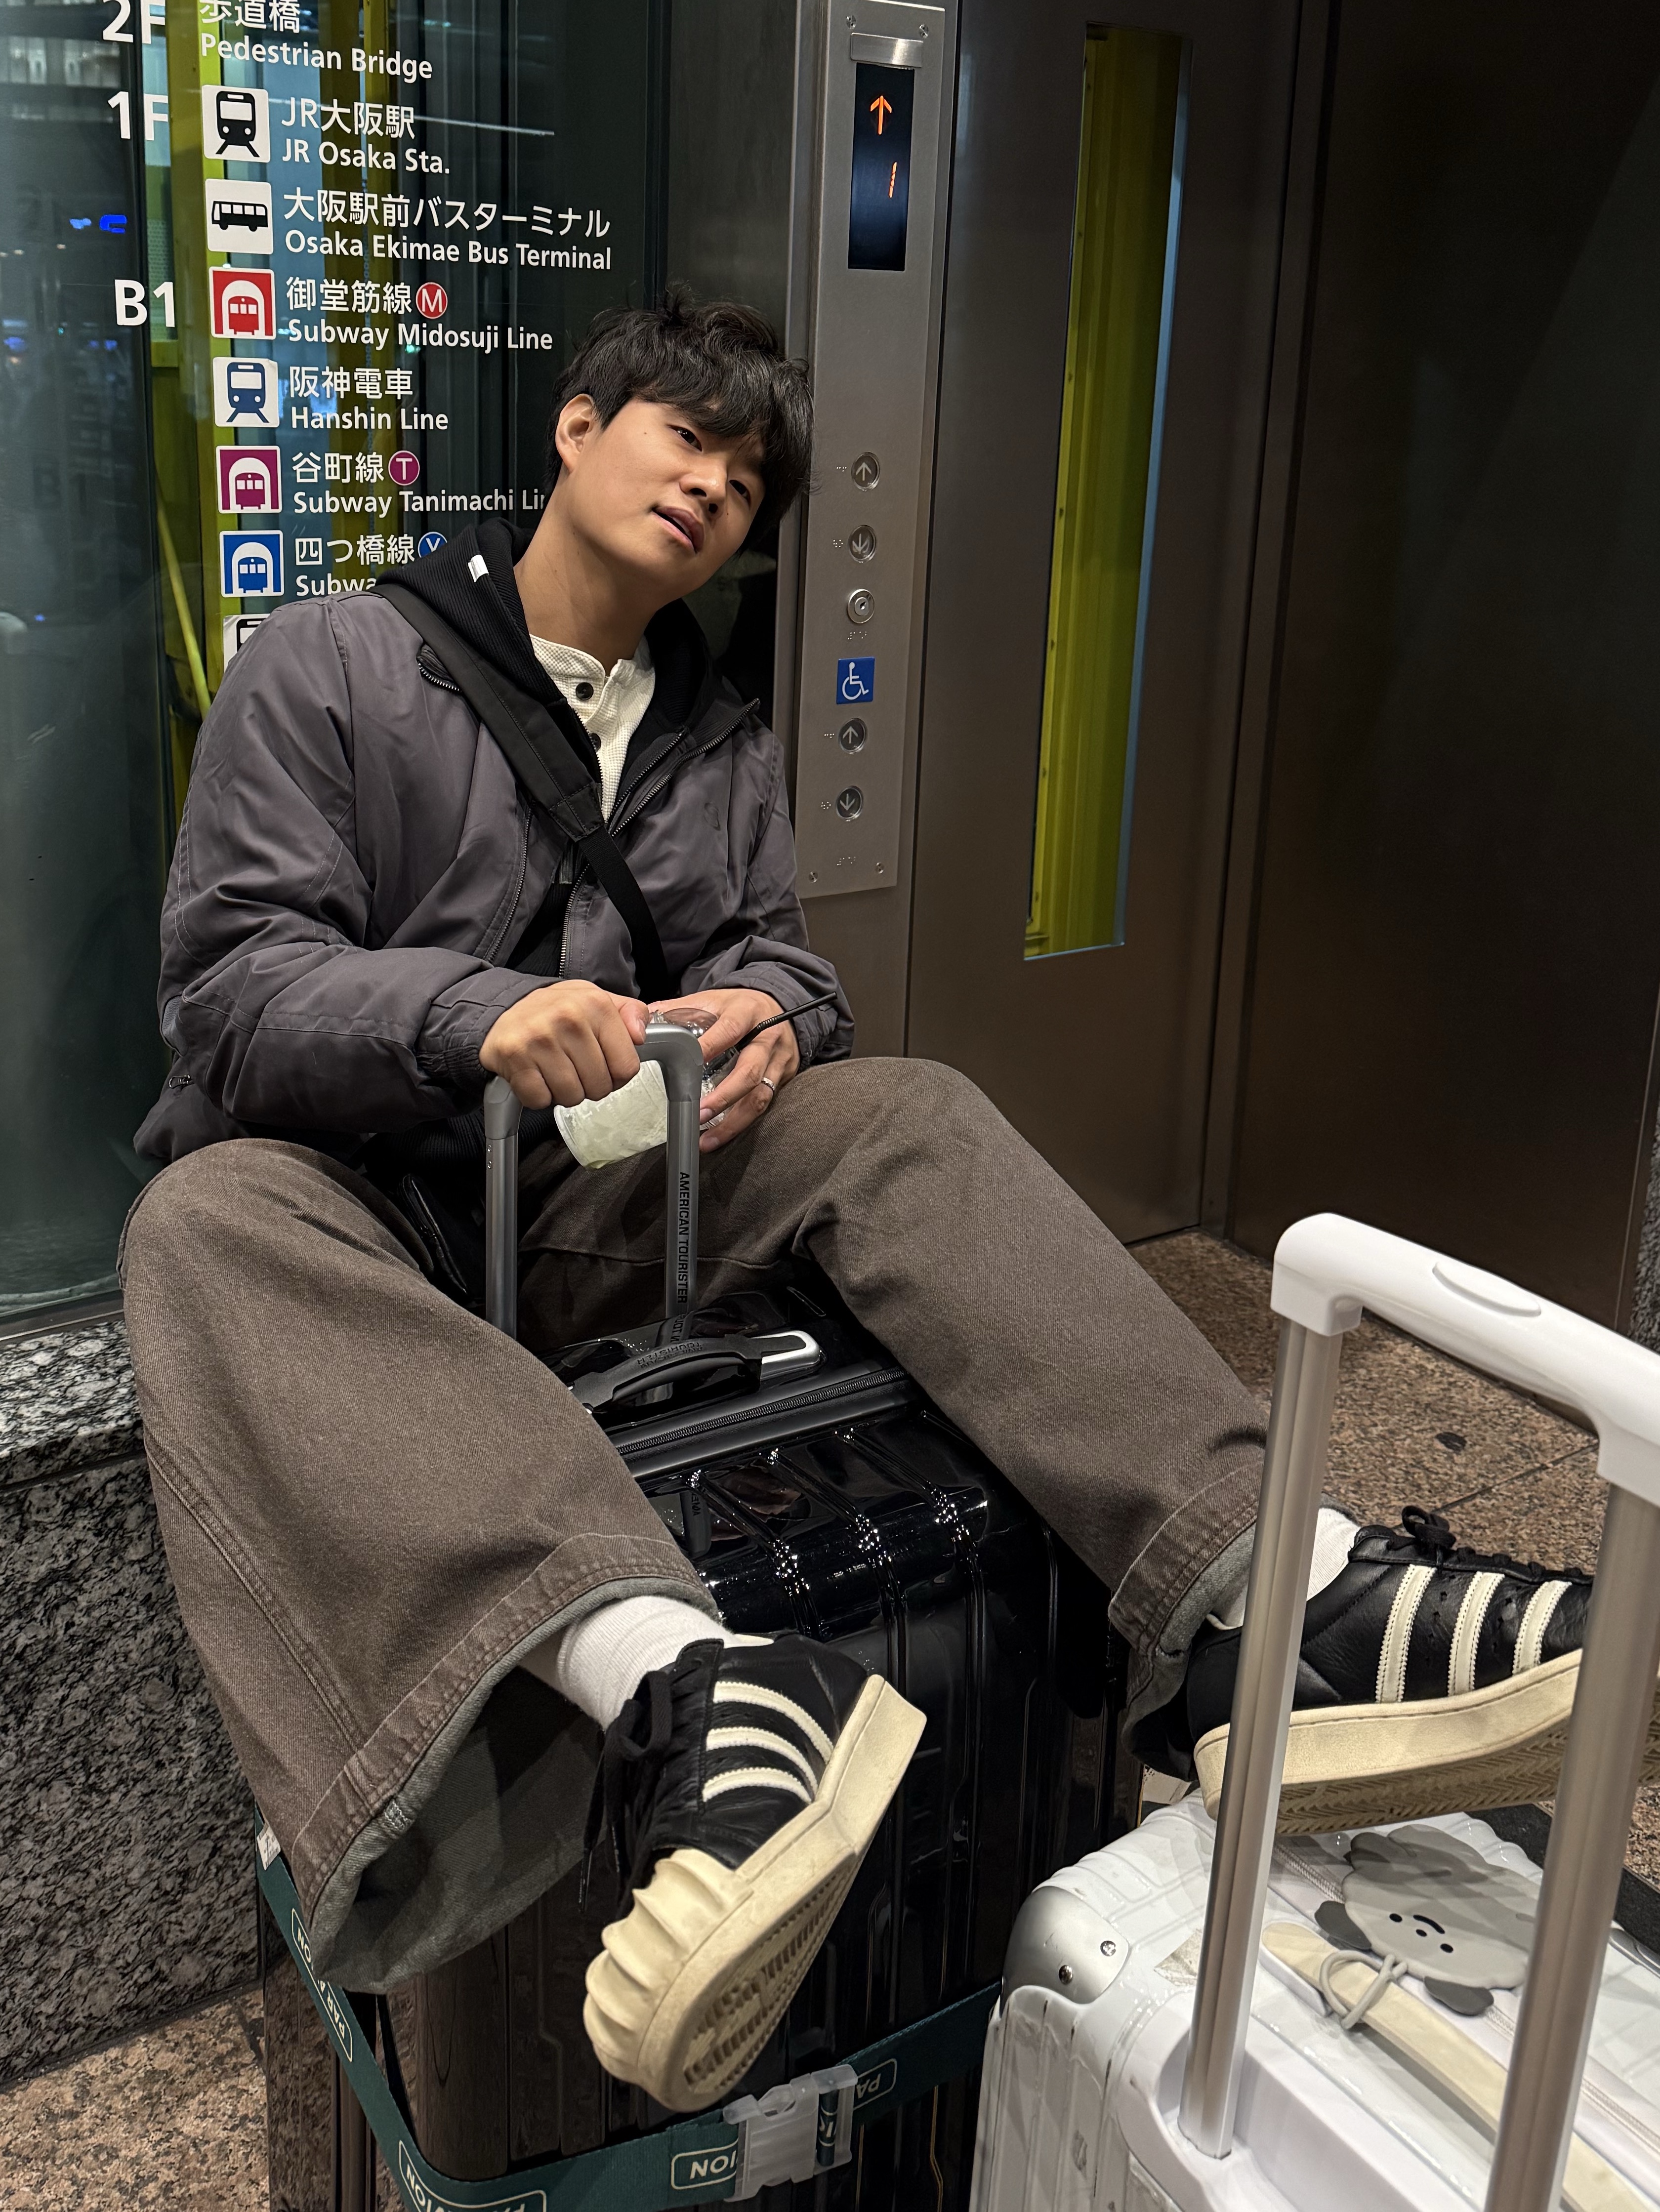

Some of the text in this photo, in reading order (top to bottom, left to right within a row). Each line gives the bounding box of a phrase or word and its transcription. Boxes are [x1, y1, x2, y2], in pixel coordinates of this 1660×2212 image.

[103, 0, 166, 44] 2F
[199, 0, 301, 33] 歩道橋
[201, 33, 432, 83] Pedestrian Bridge
[108, 91, 168, 141] 1F
[281, 97, 415, 140] JR大阪駅
[282, 138, 450, 174] JR Osaka Sta.
[284, 187, 610, 238] 大阪駅前バスターミナル
[285, 229, 611, 270] Osaka Ekimae Bus Terminal
[115, 279, 175, 328] B1
[286, 277, 412, 315] 御堂筋線
[288, 319, 552, 354] Subway Midosuji Line
[290, 365, 413, 400] 阪神電車
[291, 406, 448, 431] Hanshin Line
[292, 451, 384, 483] 谷町線
[294, 488, 545, 518] Subway Tanimachi Li
[295, 533, 415, 566] 四つ橋線
[295, 573, 377, 596] Subwa
[678, 1171, 690, 1235] AMERICAN
[677, 1239, 689, 1304] TOURISTER
[328, 1990, 345, 2040] PAR
[857, 2073, 881, 2099] PA
[689, 2149, 738, 2180] ION
